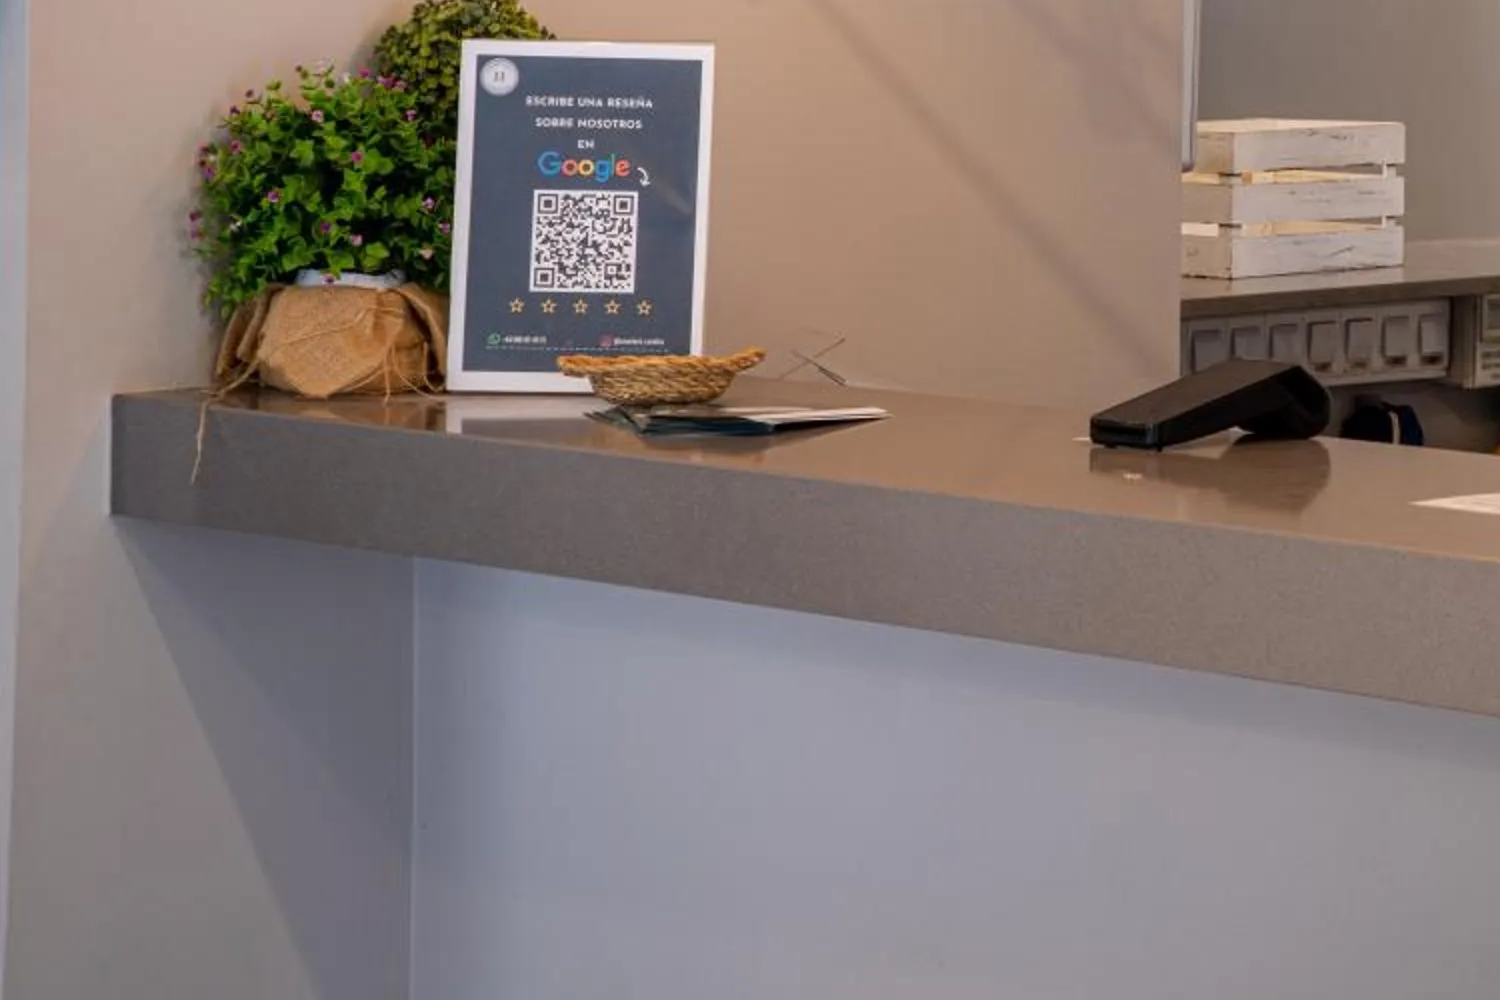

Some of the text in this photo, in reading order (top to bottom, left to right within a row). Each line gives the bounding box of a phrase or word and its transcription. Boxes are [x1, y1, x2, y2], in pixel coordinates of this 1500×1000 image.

[525, 95, 653, 109] ESCRIBE UNA RESEÑA
[535, 117, 643, 129] SOBRE NOSOTROS
[577, 138, 596, 149] EN
[537, 150, 631, 183] Google
